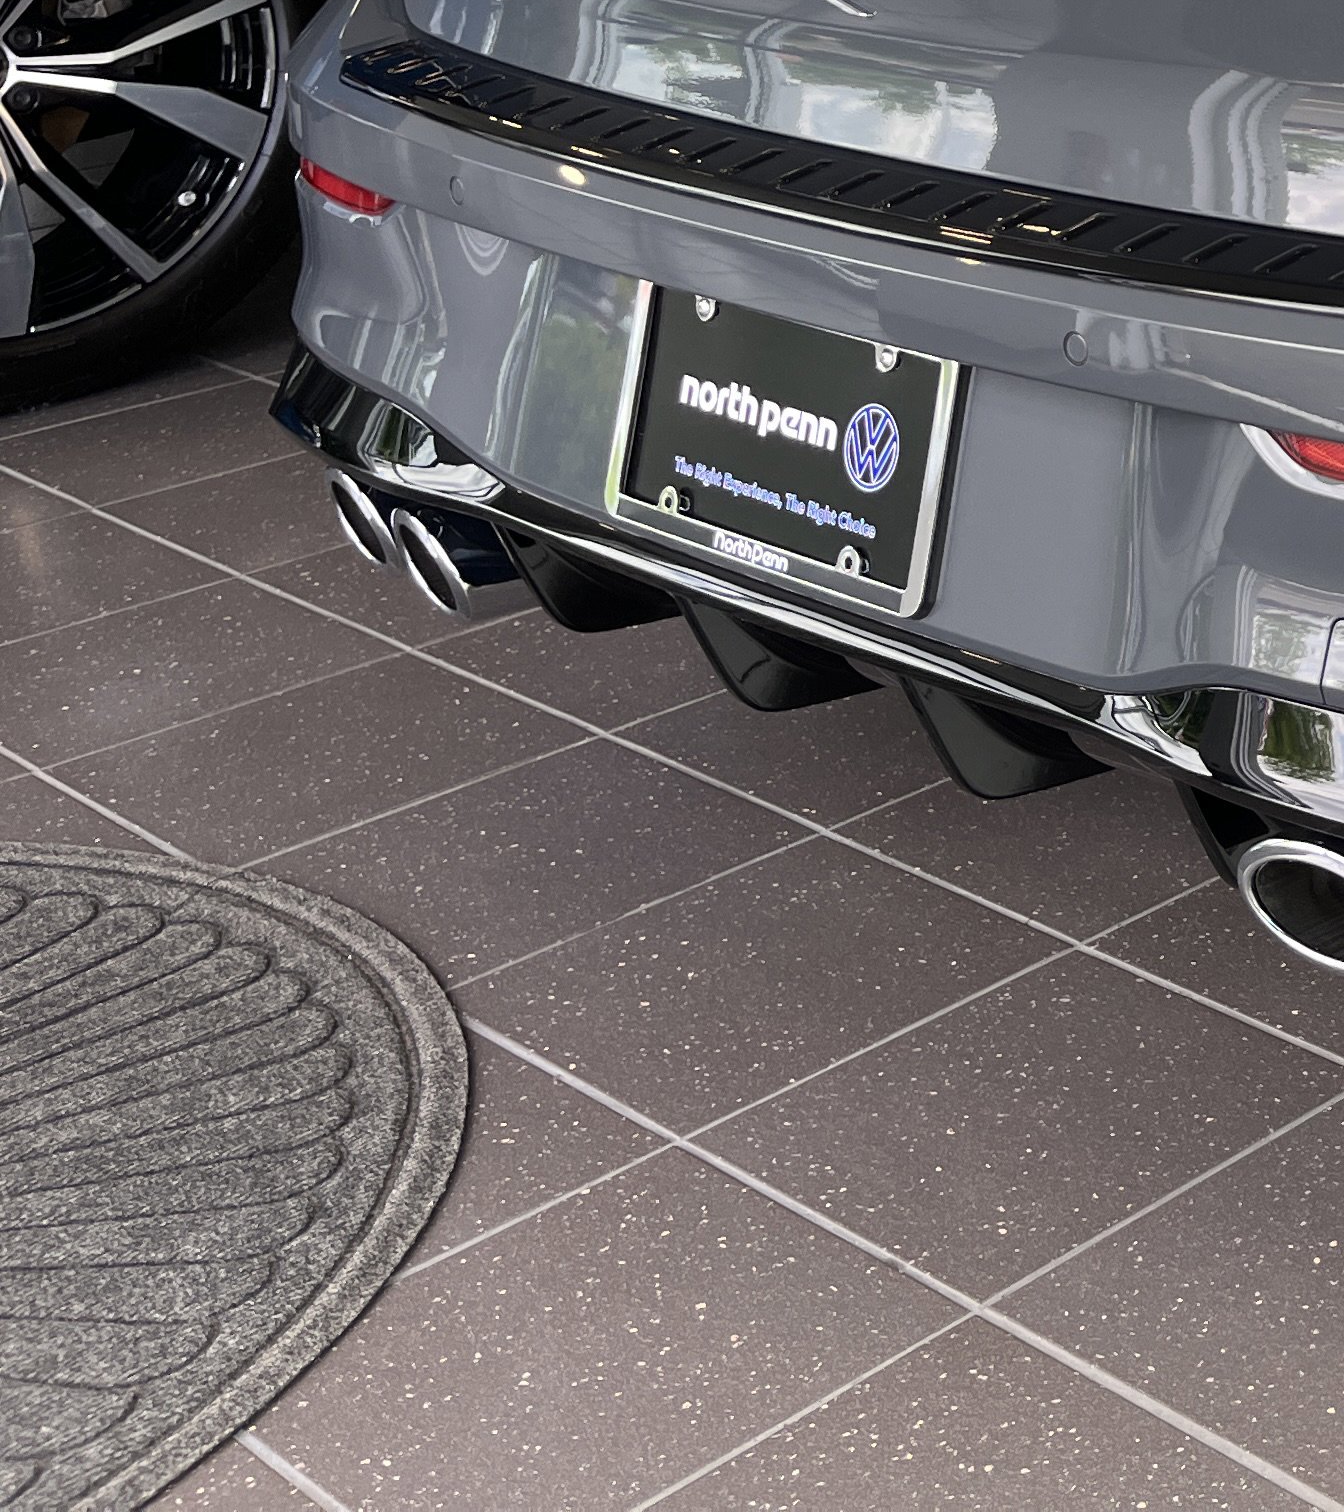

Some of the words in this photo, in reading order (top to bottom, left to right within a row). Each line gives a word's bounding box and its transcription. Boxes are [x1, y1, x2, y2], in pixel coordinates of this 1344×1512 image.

[675, 455, 694, 477] The
[694, 462, 723, 487] Right
[723, 471, 783, 510] Experience,
[785, 492, 806, 515] The
[806, 500, 837, 526] Right
[838, 511, 876, 539] Choice
